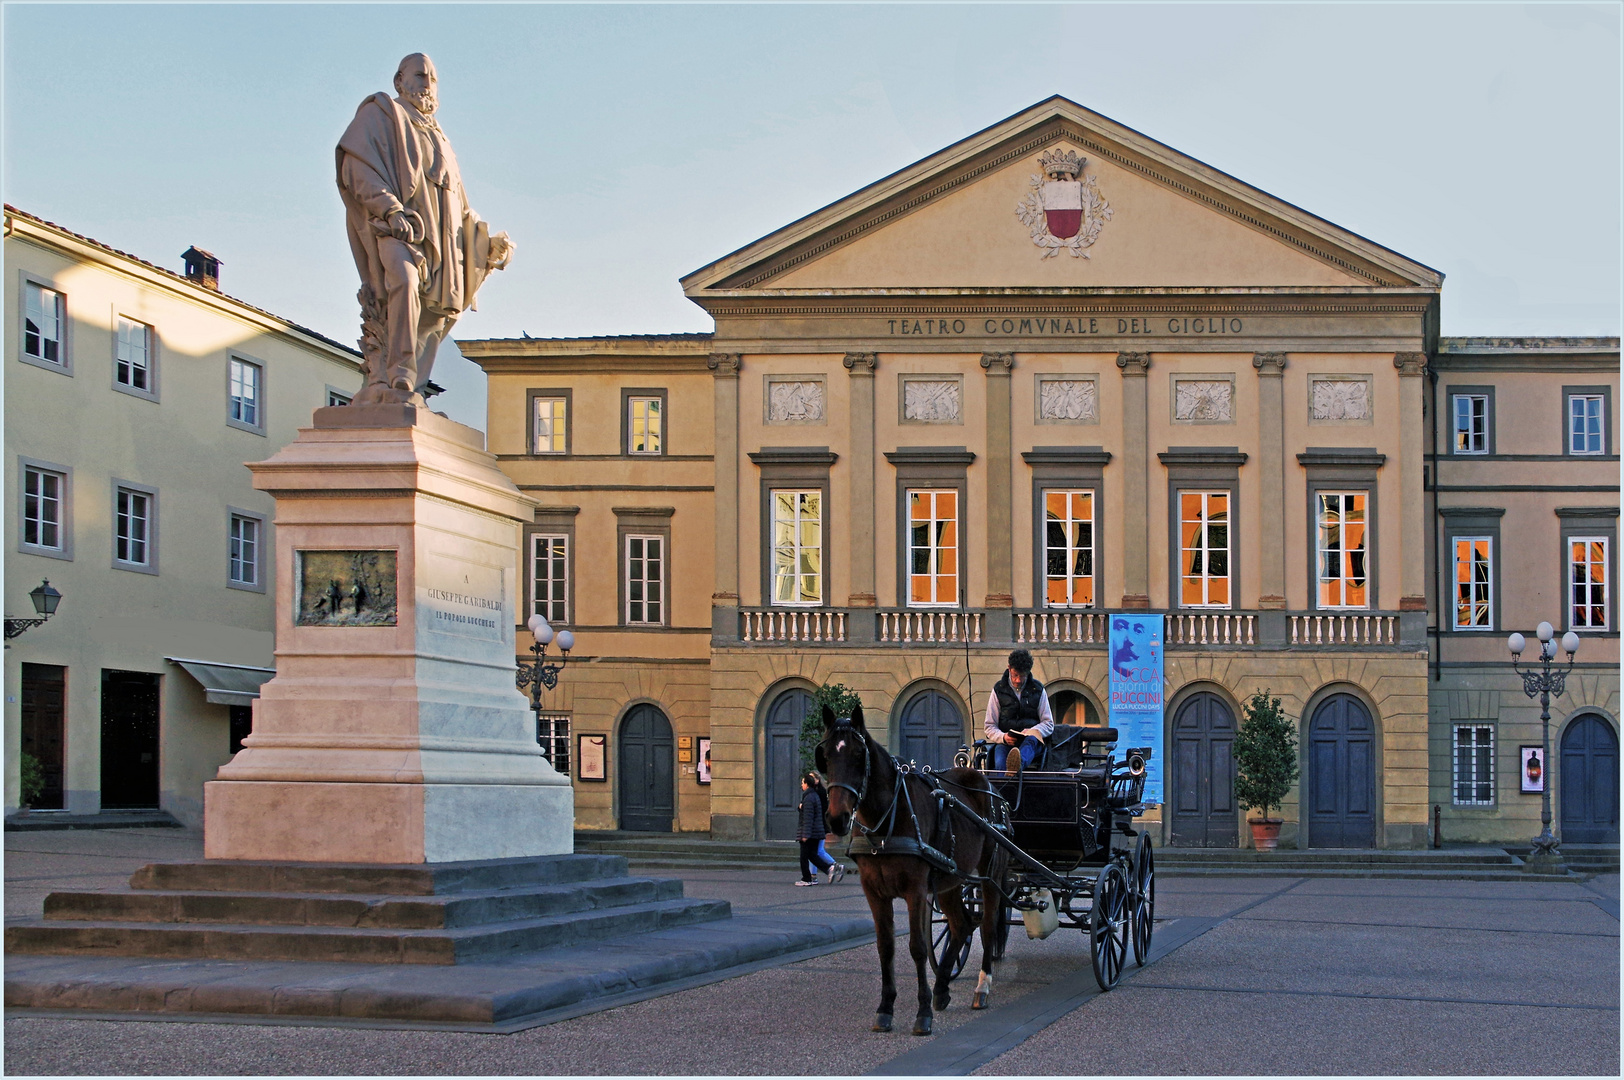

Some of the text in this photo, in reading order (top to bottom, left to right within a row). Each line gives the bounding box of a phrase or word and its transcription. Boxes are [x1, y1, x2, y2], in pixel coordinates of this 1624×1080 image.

[888, 317, 1243, 335] TEATRO COMVNALE DEL GIGLIO
[464, 575, 469, 584] A
[428, 588, 502, 611] GIUSEPPE GARIBALDI
[436, 611, 495, 628] IL POPOLO LUCCHESE
[1112, 667, 1160, 683] LUCCA
[1151, 680, 1161, 692] di
[1112, 691, 1161, 704] PUCCINI
